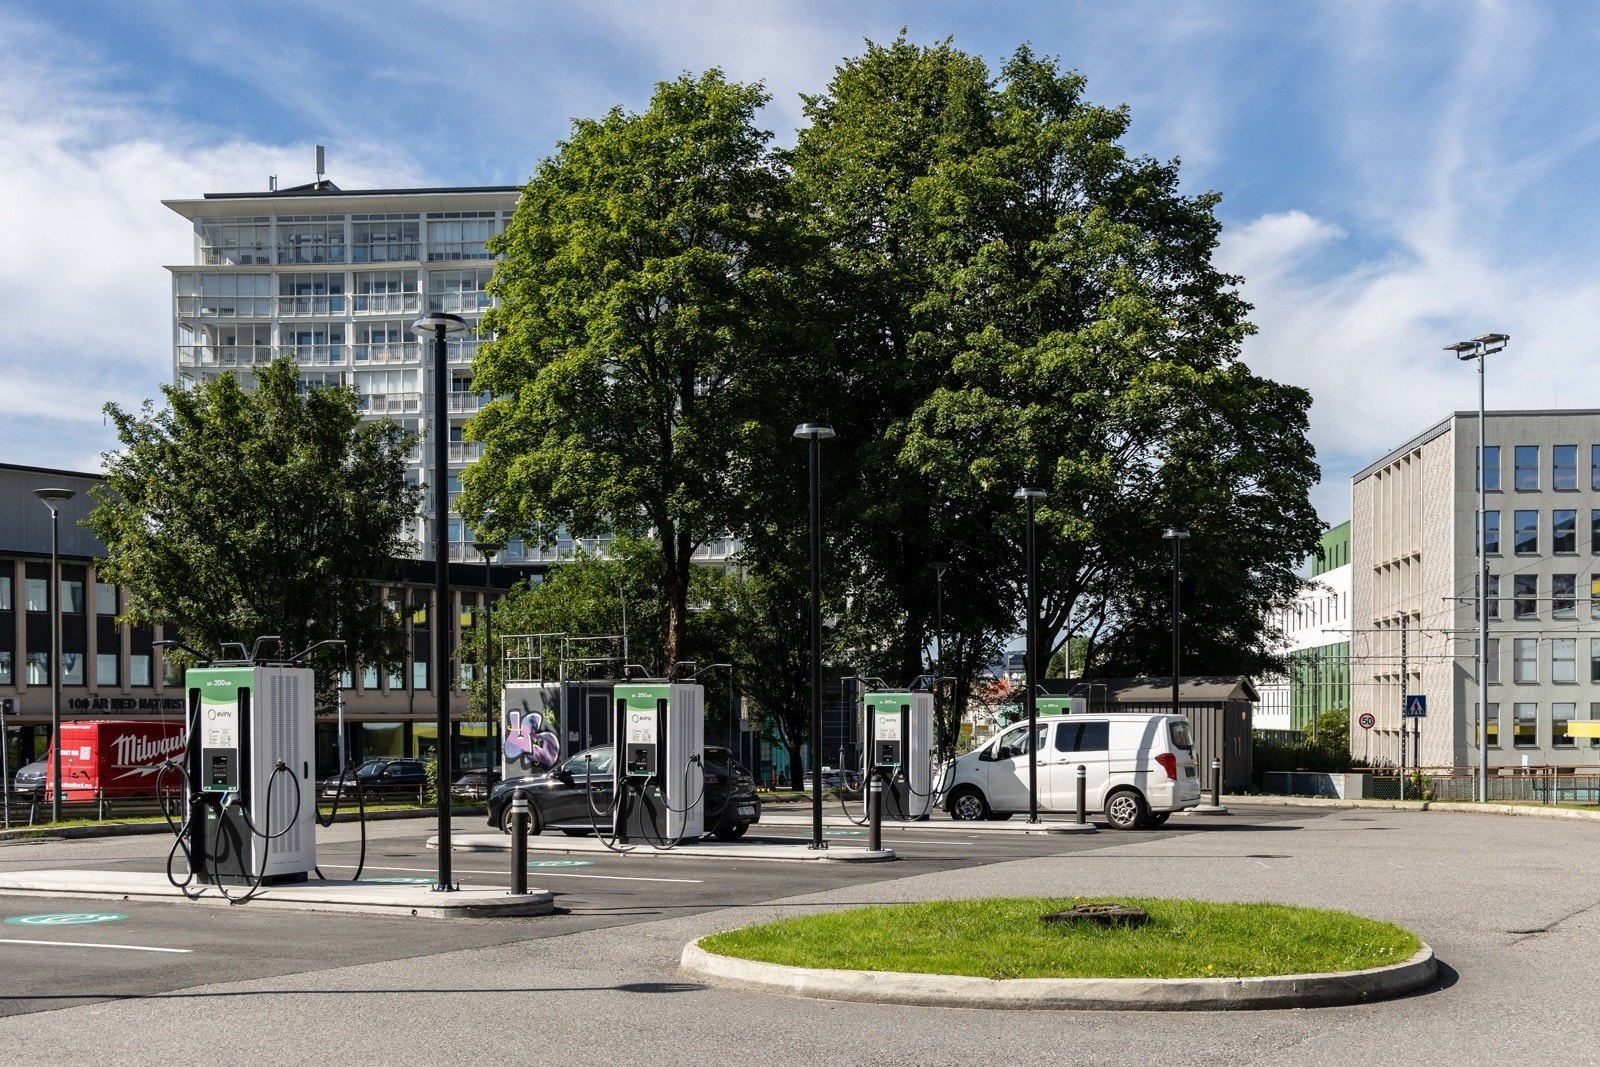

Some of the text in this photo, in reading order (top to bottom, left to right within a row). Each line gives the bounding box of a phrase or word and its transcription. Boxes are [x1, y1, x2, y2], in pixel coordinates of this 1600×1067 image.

[68, 697, 89, 709] 100
[216, 710, 232, 718] eviny
[1361, 716, 1373, 725] 50
